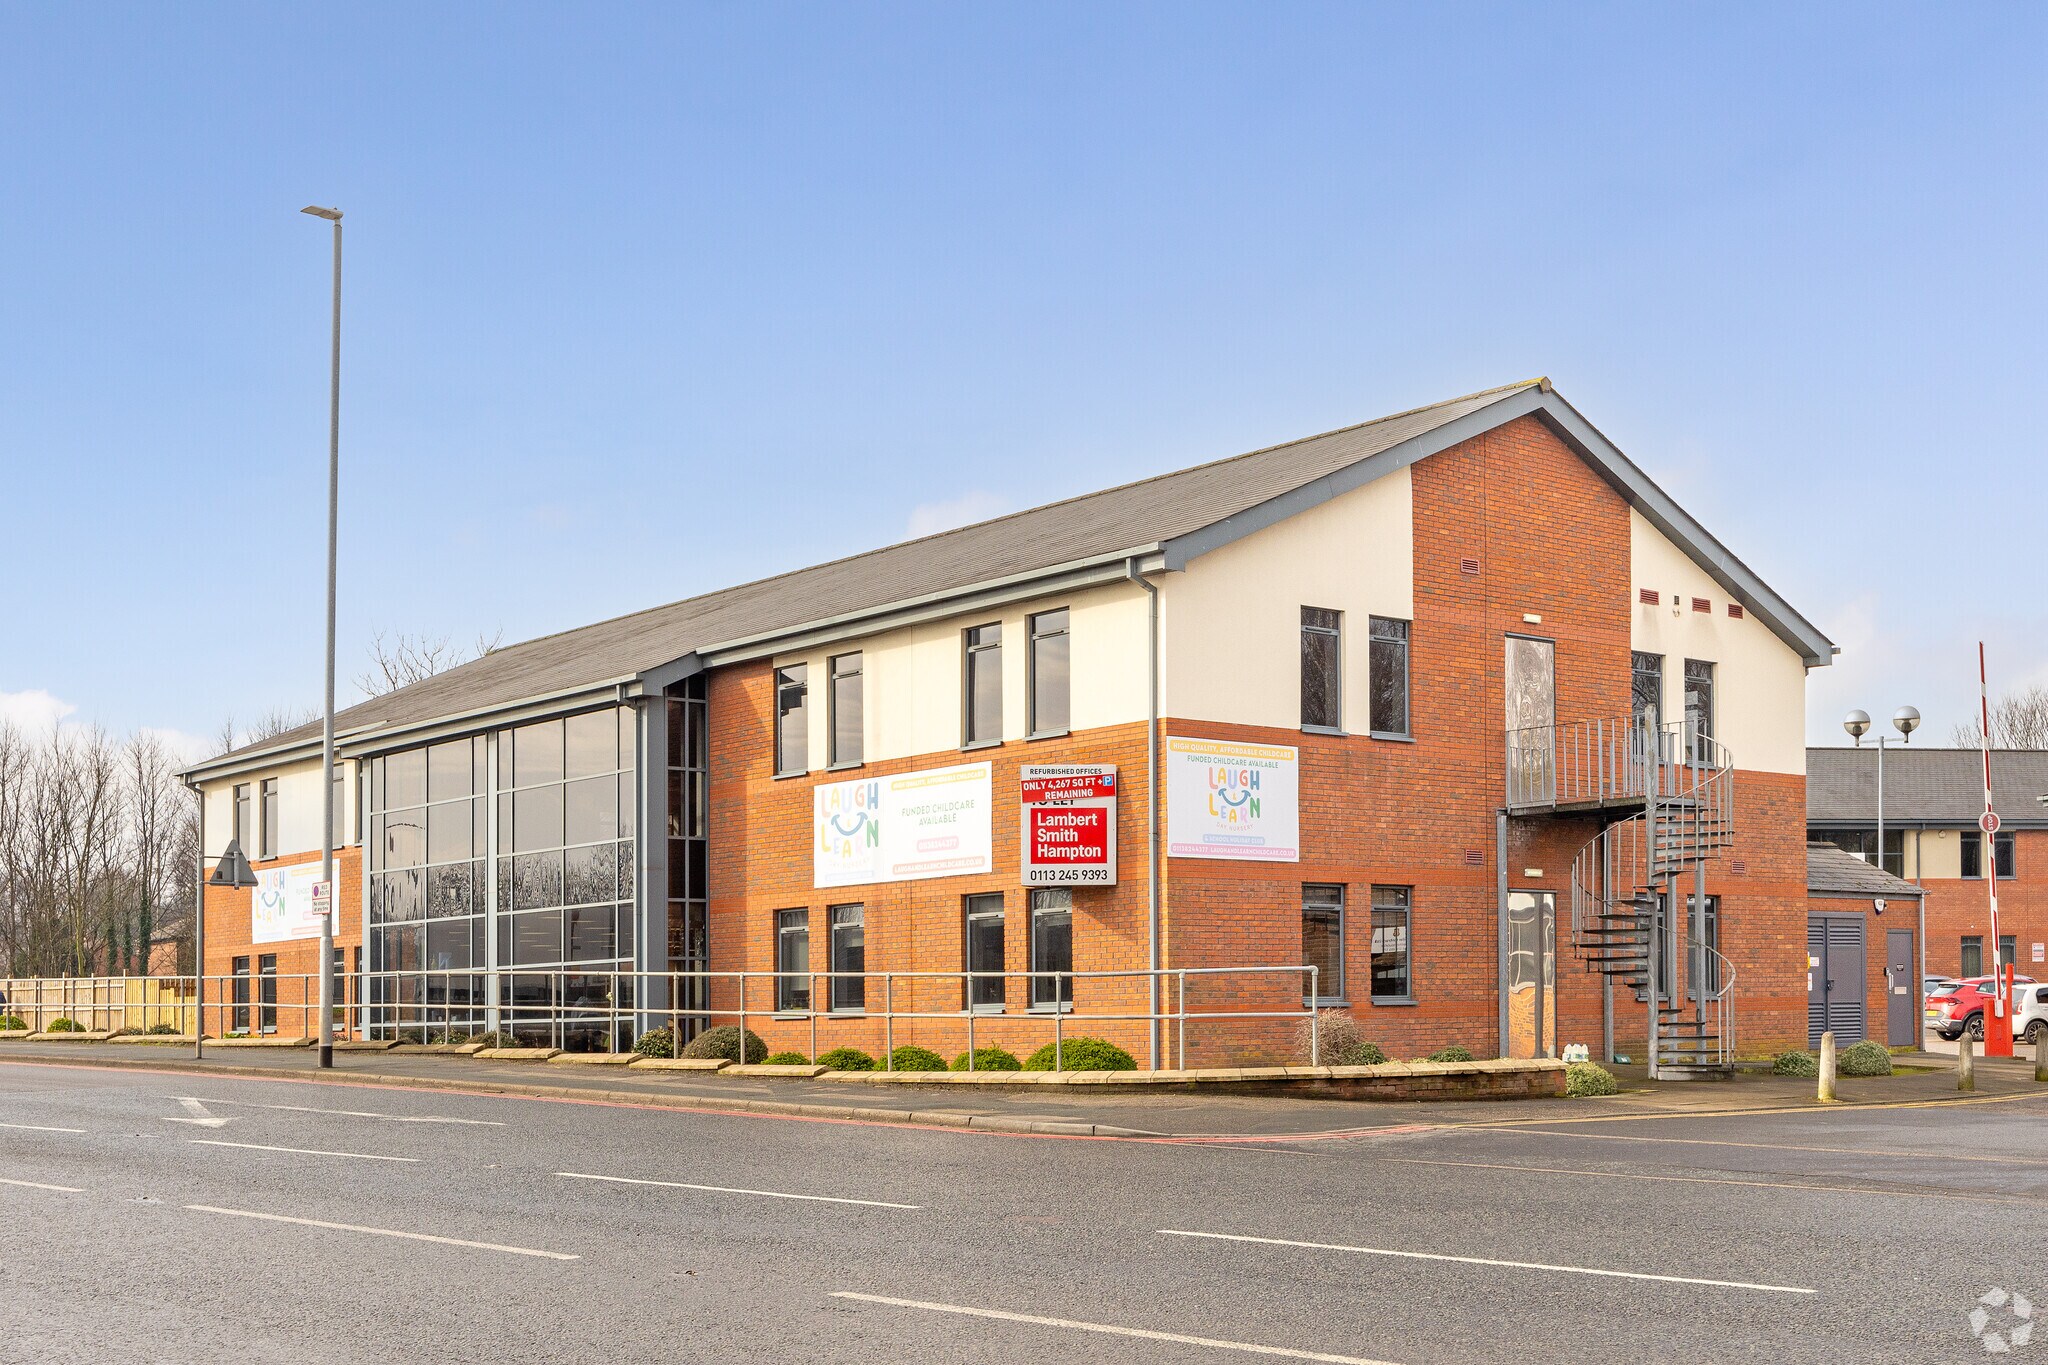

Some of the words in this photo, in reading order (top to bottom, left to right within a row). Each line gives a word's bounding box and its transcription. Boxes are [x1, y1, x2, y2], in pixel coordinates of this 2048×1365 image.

[1173, 742, 1189, 750] HIGH
[1220, 746, 1258, 756] AFFORDABLE
[1259, 749, 1291, 758] CHILDCARE
[1187, 754, 1212, 763] FUNDED
[1213, 757, 1247, 766] CHILDCARE
[1248, 760, 1279, 769] AVAILABLE
[1023, 781, 1046, 791] ONLY
[1047, 779, 1070, 790] 4,267
[1072, 778, 1084, 787] SQ
[1085, 777, 1096, 786] FT
[1209, 766, 1260, 791] LAUGH
[821, 782, 878, 818] LAUGH
[1045, 788, 1093, 800] REMAINING
[901, 805, 930, 817] FUNDED
[933, 799, 975, 813] CHILDCARE
[1208, 793, 1261, 824] LEARN
[918, 813, 957, 826] AVAILABLE
[1037, 812, 1098, 826] Lambert
[1229, 822, 1254, 832] NURSERY
[821, 819, 879, 859] LEARN
[1037, 828, 1079, 842] Smith
[1037, 844, 1101, 860] Hampton
[1030, 869, 1056, 881] 0113
[1058, 869, 1079, 881] 245
[1081, 869, 1108, 880] 9393
